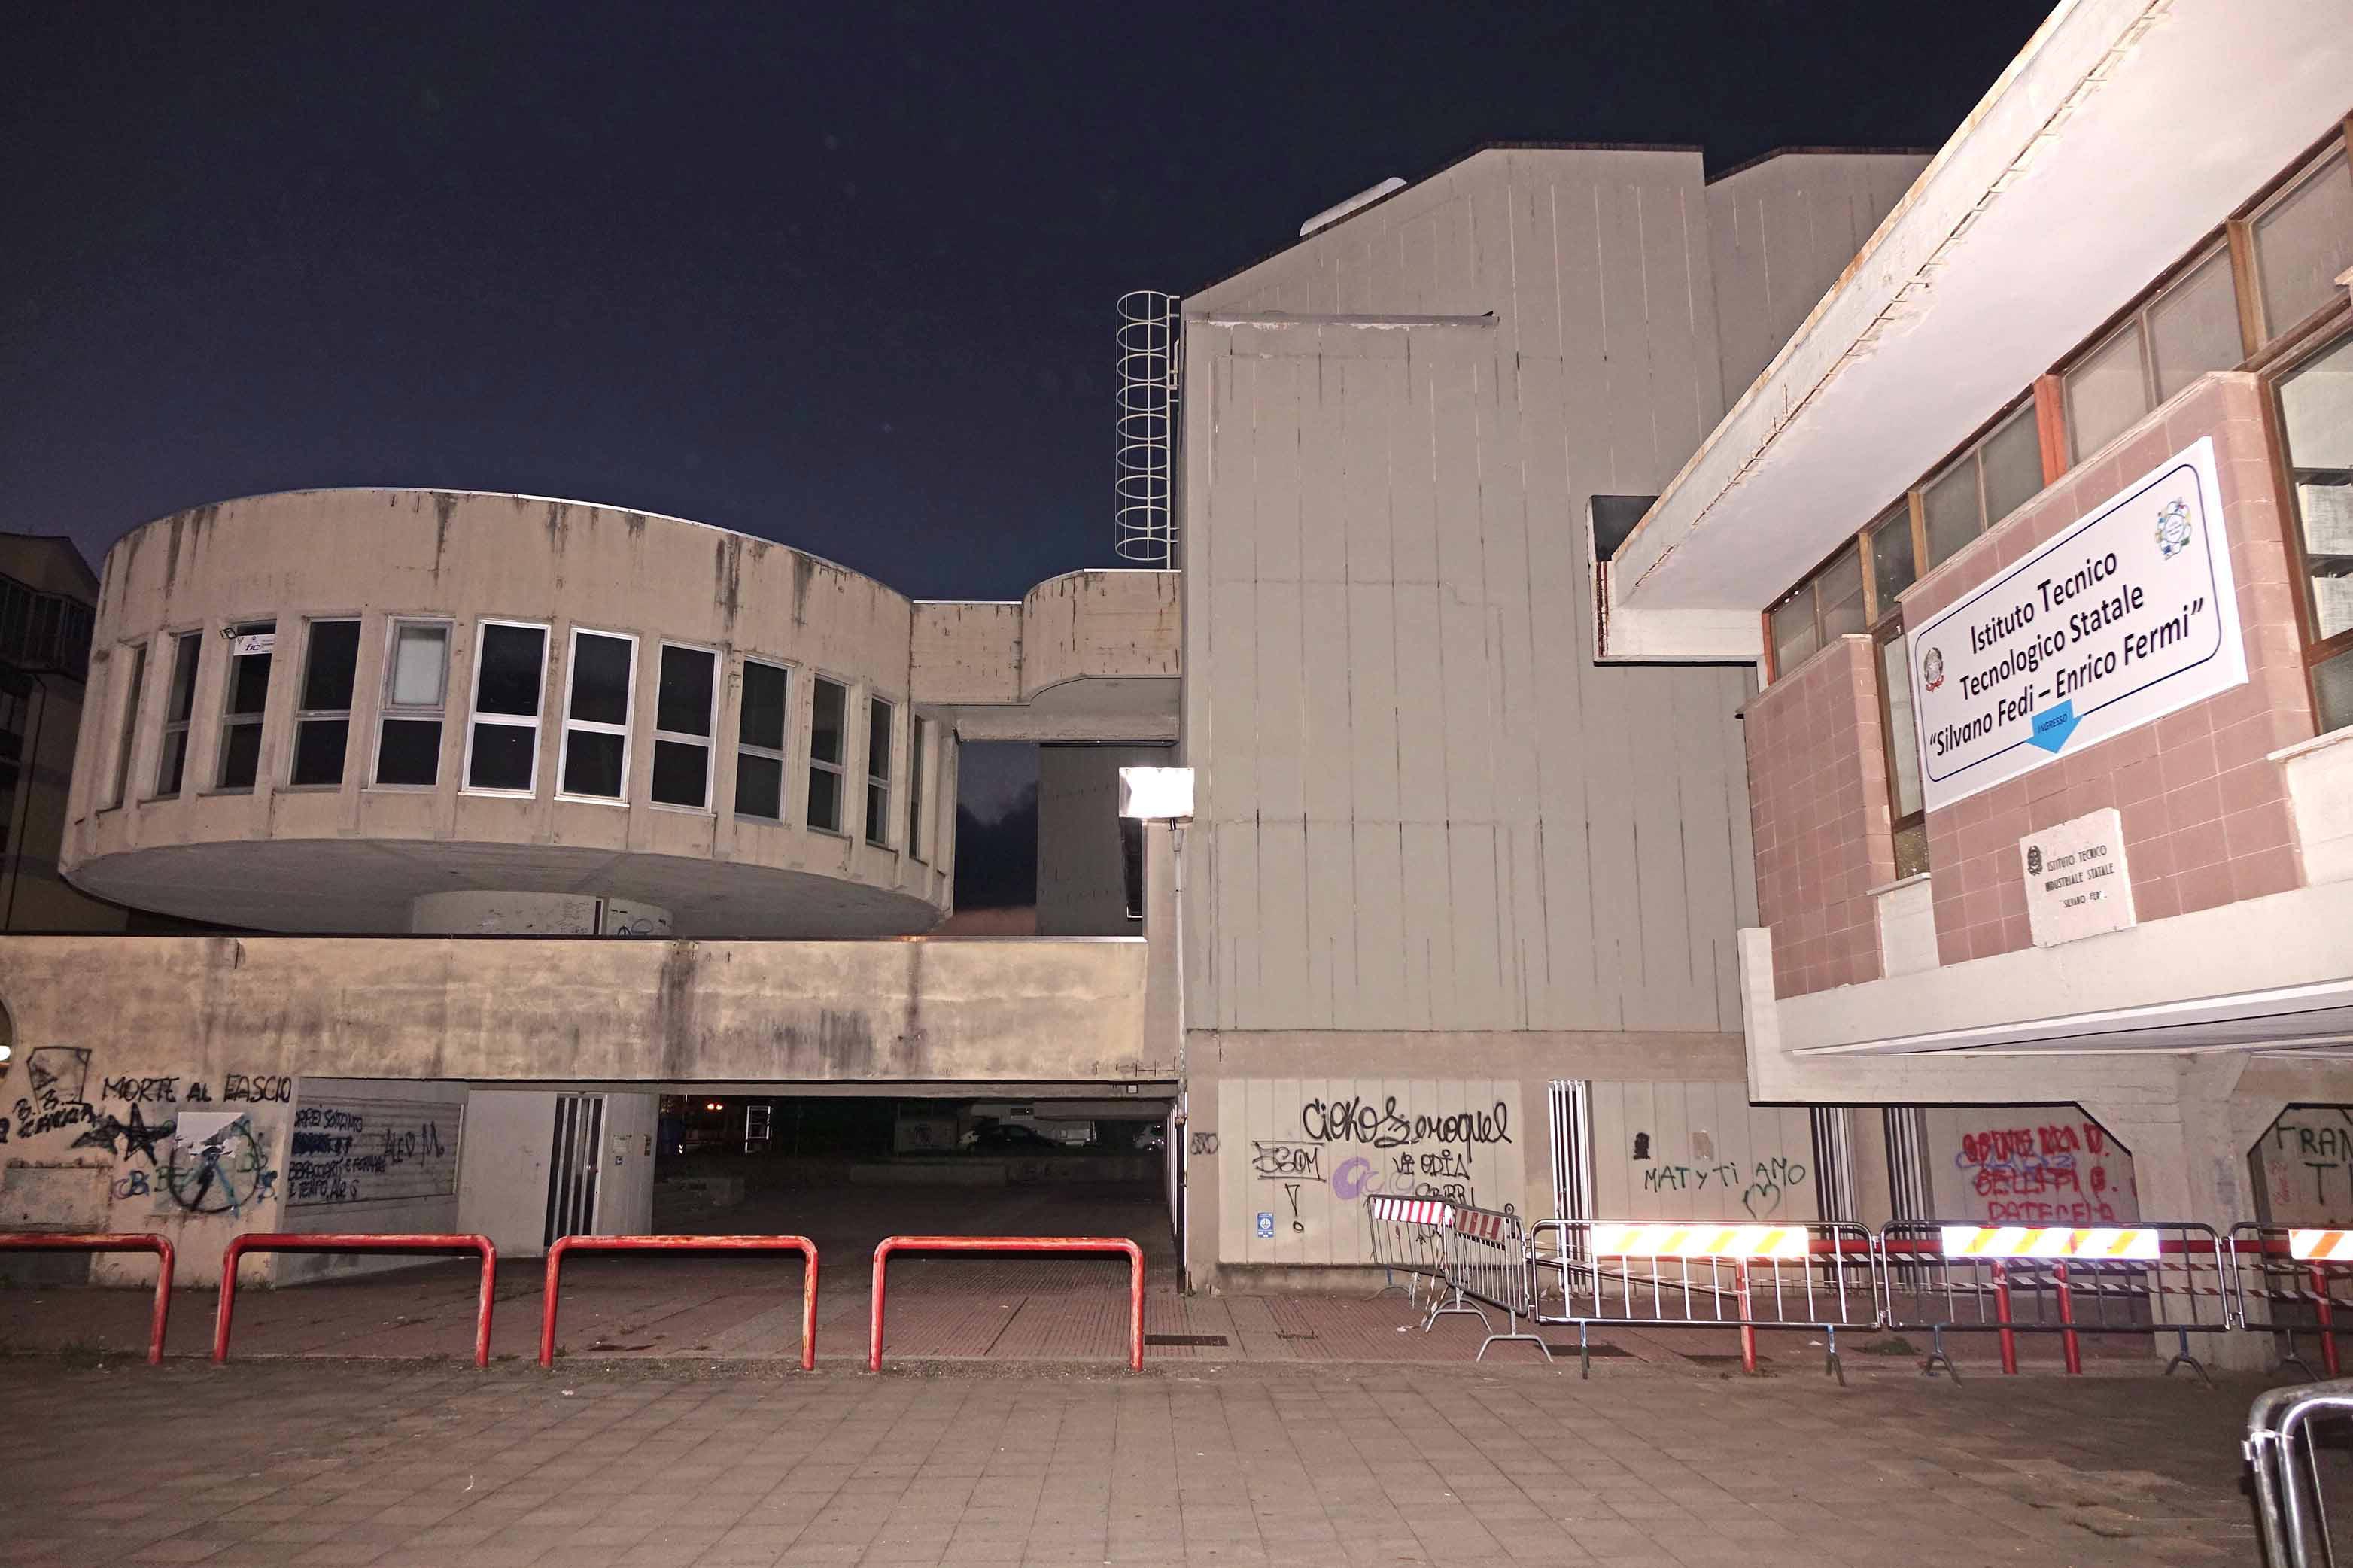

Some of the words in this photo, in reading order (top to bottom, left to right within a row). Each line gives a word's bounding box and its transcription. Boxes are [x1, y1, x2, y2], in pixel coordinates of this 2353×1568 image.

[1970, 602, 2035, 654] Istituto
[2038, 552, 2117, 612] Tecnico
[1960, 631, 2066, 700] Tecnologico
[2069, 585, 2144, 643] Statale
[1998, 684, 2033, 726] Fedi
[2057, 651, 2116, 698] Enrico
[2038, 713, 2067, 734] INGRESSO
[2047, 855, 2075, 871] ISTITUTO
[2078, 845, 2107, 862] TECNICO
[2045, 872, 2084, 892] INDUSTRIALE
[2087, 863, 2114, 880] STATALE
[102, 1077, 180, 1102] MORTE
[187, 1083, 212, 1102] AL
[1756, 1156, 1806, 1187] AMO
